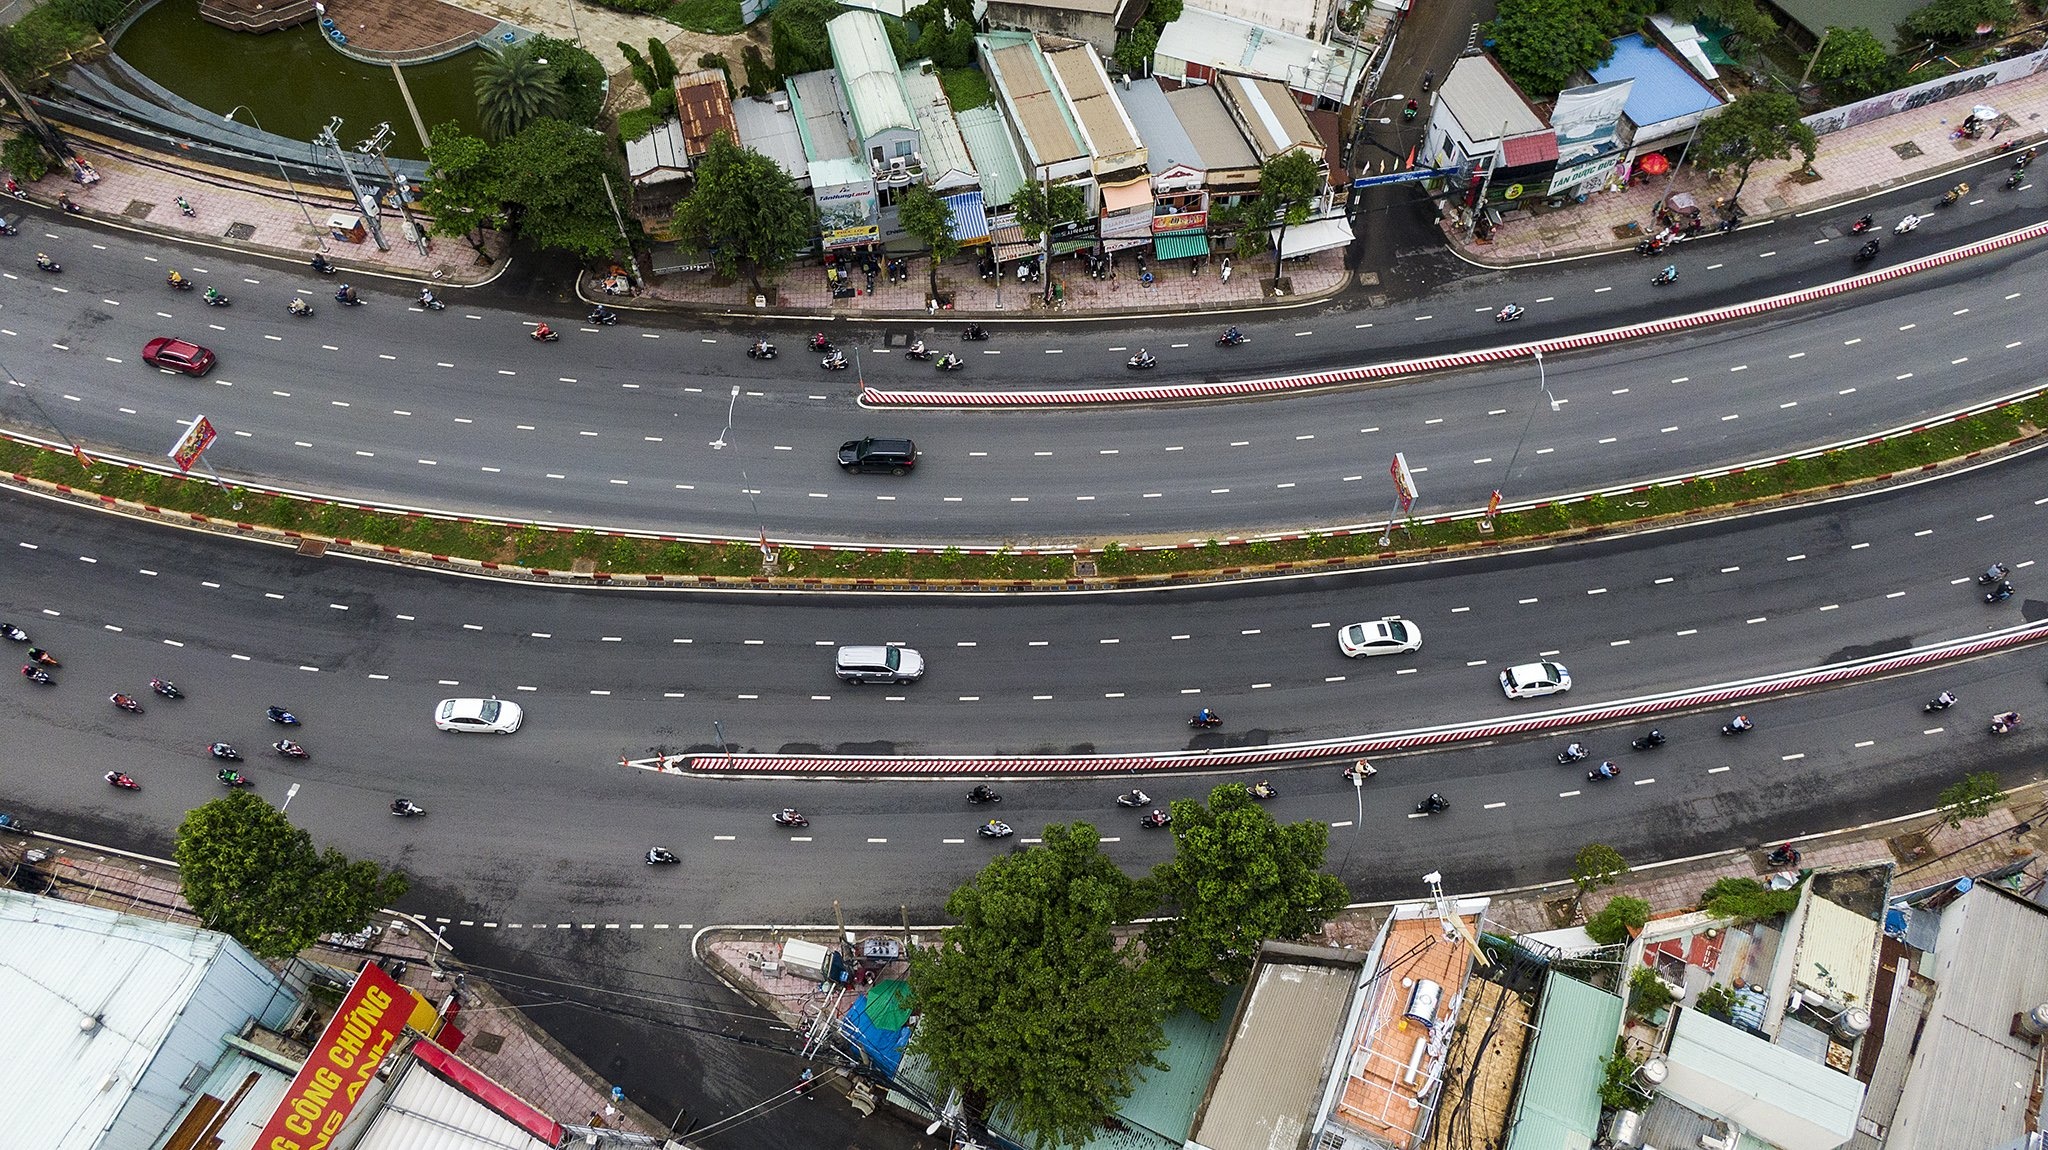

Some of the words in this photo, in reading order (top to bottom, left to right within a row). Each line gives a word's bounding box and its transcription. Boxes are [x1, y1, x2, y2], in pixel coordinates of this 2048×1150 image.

[285, 1067, 343, 1136] CÔNG
[328, 985, 392, 1069] CHỨNG
[346, 1029, 394, 1104] ANH
